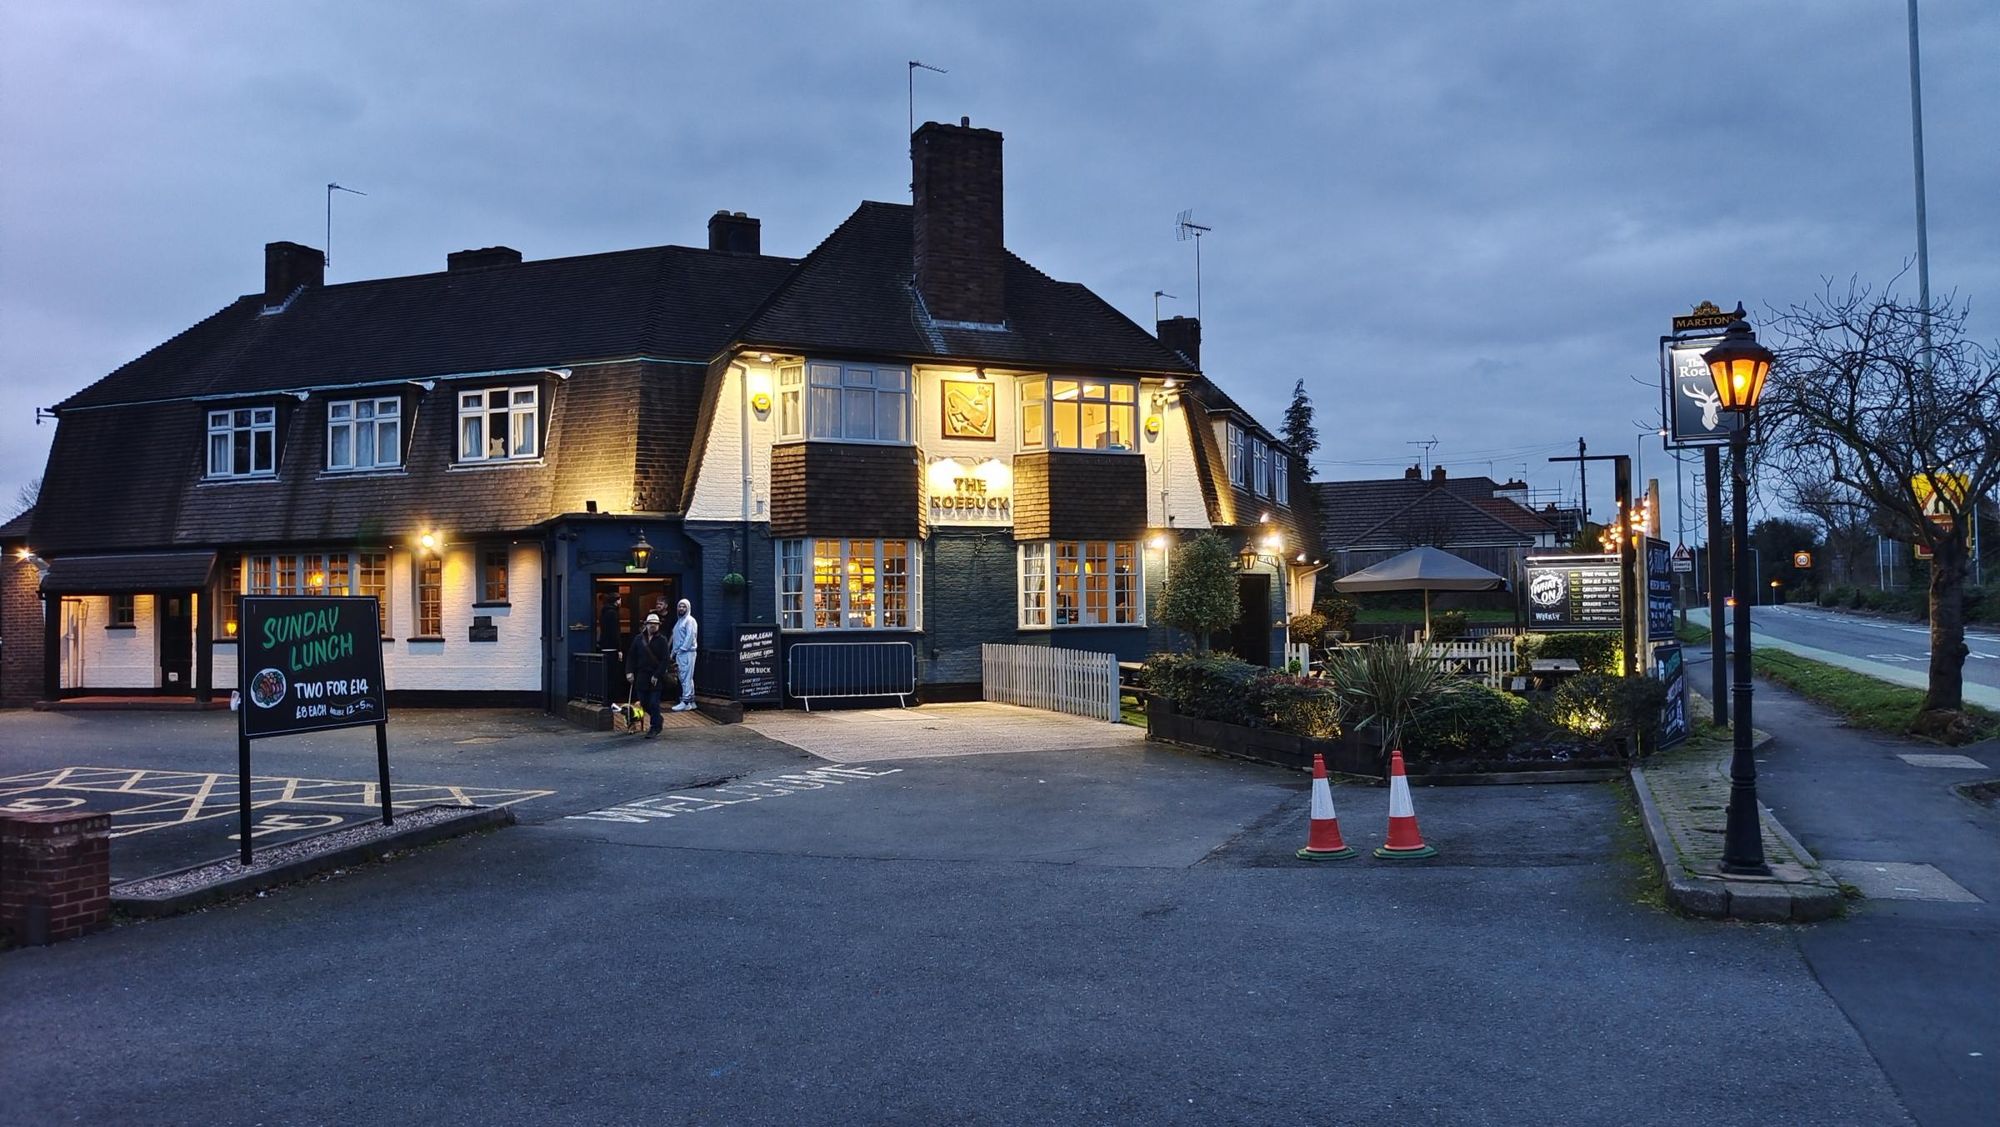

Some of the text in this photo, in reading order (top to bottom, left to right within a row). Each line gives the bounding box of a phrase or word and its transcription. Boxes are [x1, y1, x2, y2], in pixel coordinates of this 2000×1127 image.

[1686, 358, 1704, 368] The
[953, 478, 987, 492] THE
[930, 495, 1009, 510] ROEBUCK
[1534, 579, 1562, 594] WHAT'S
[1541, 589, 1556, 603] ON
[262, 606, 339, 649] SUNDAY
[291, 632, 353, 671] LUNCH
[294, 678, 369, 699] TWO FOR £14
[295, 704, 308, 719] £8
[308, 704, 327, 717] EACH
[563, 764, 904, 823] WELCOME
